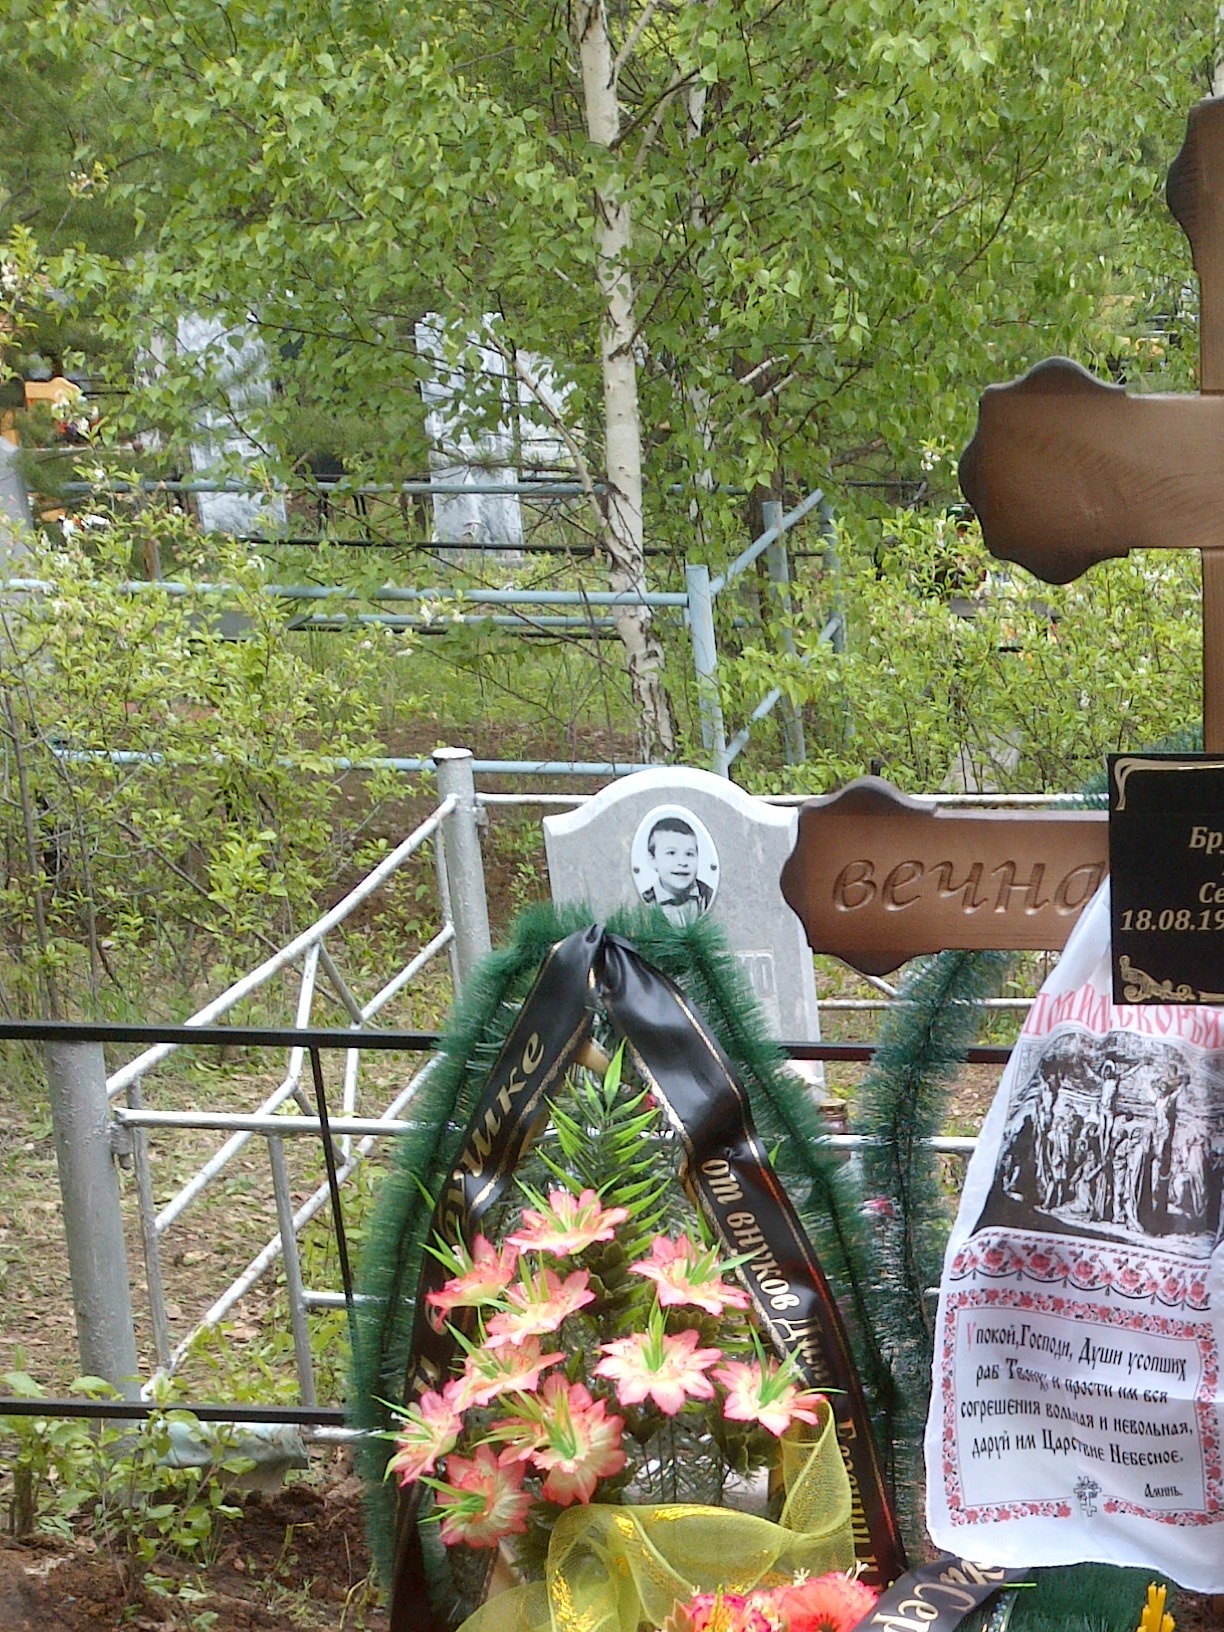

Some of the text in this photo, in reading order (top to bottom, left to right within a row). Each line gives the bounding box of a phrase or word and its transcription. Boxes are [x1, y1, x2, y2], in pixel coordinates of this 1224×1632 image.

[831, 858, 1107, 917] вечна
[701, 1158, 731, 1206] от
[726, 1209, 801, 1312] внуков
[1020, 1324, 1073, 1362] Господи,
[1078, 1337, 1124, 1370] Души
[1128, 1351, 1187, 1382] усопших
[976, 1364, 1000, 1387] раб
[1051, 1375, 1061, 1390] и
[1064, 1377, 1114, 1401] прости
[1117, 1385, 1138, 1402] им
[1143, 1389, 1169, 1404] вся
[960, 1398, 1194, 1437] согрешения вольная и невольная,
[971, 1427, 1185, 1467] даруй им Царствие Небесное.
